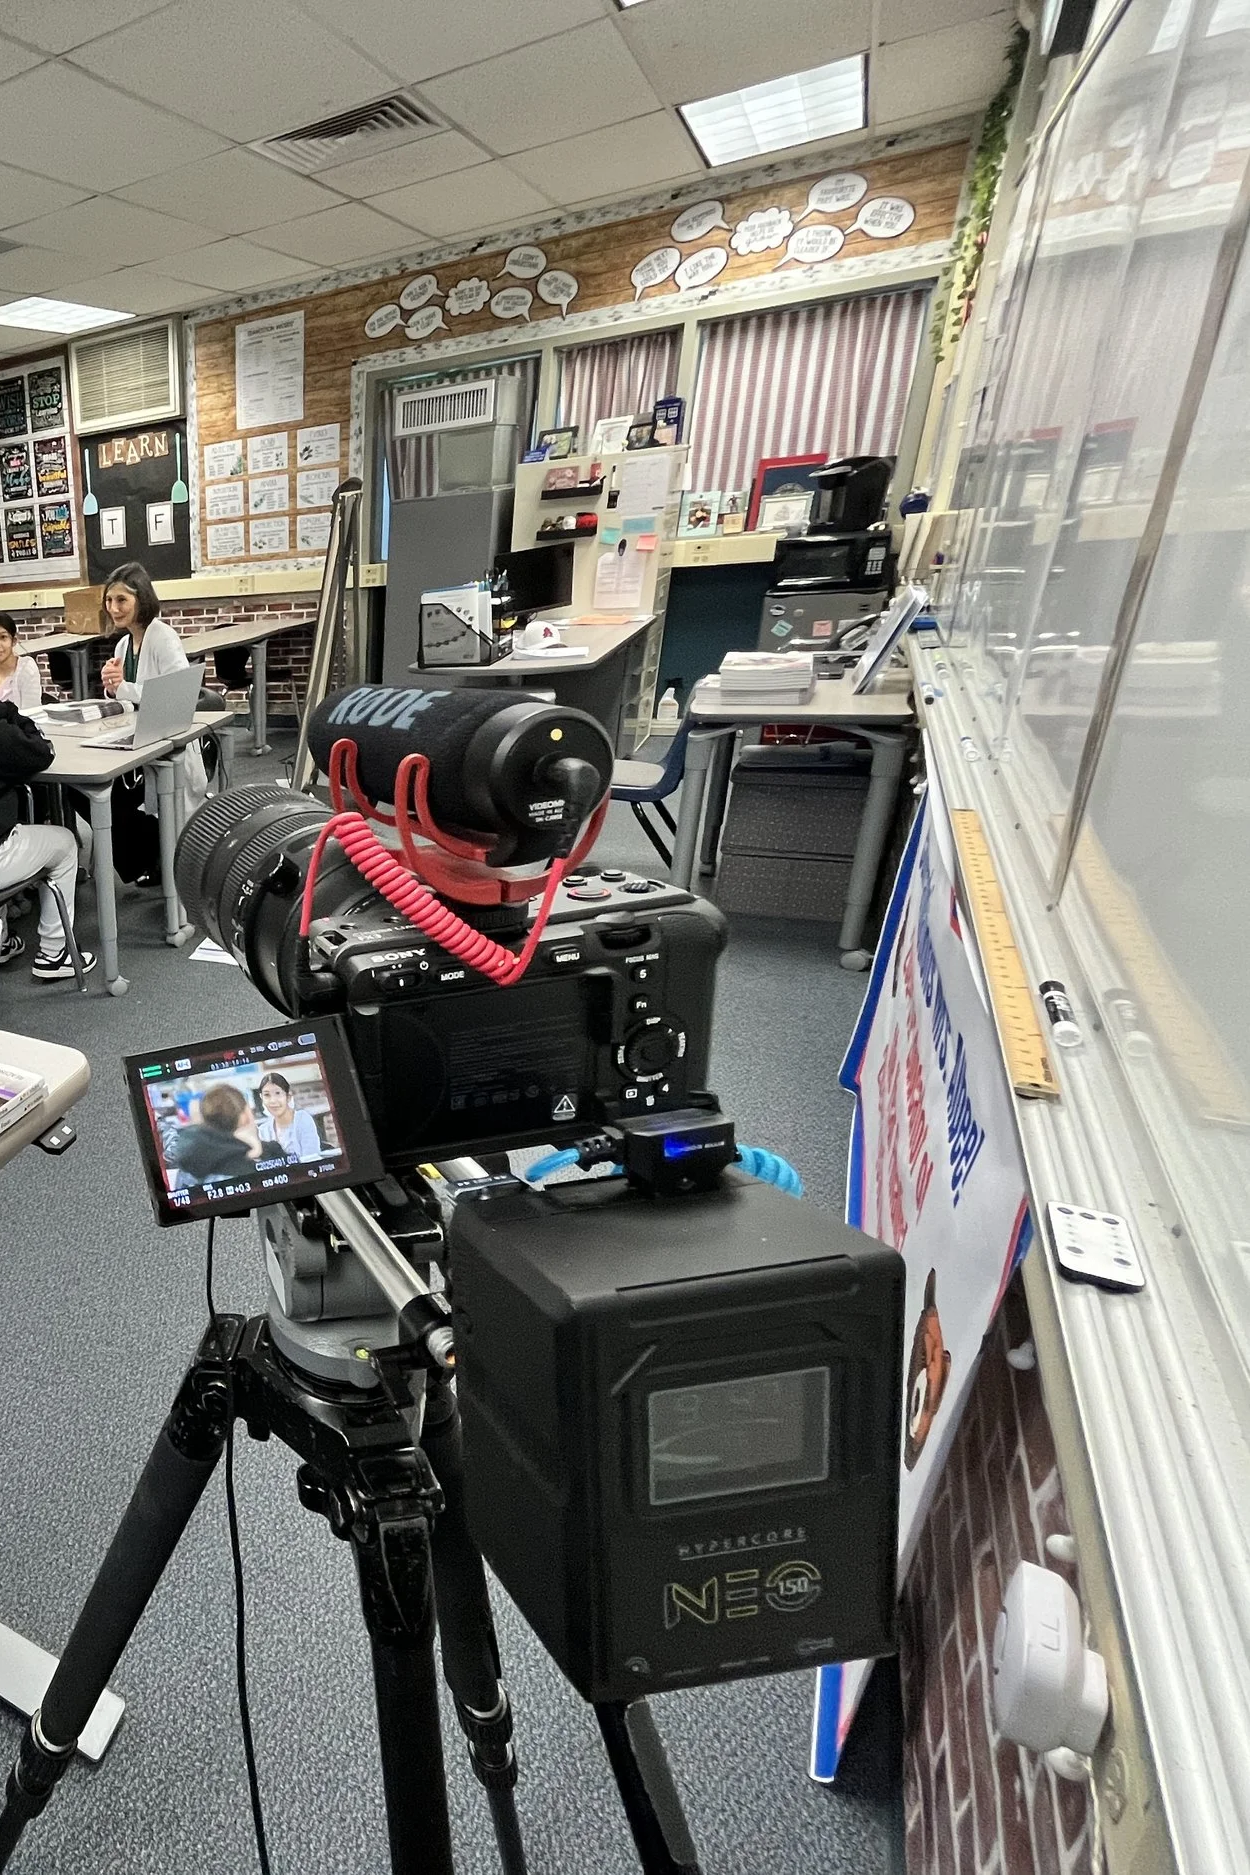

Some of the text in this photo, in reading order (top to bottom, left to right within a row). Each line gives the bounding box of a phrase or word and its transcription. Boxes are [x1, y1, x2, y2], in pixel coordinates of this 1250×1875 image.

[32, 393, 61, 409] STOP
[101, 432, 167, 466] LEARN
[107, 518, 118, 535] T
[154, 513, 165, 531] F
[371, 949, 426, 964] SONY
[555, 952, 580, 963] MENU
[440, 970, 465, 981] MODE
[636, 1001, 647, 1009] Fn
[274, 1174, 289, 1185] 400
[207, 1188, 224, 1200] F2.8
[235, 1182, 252, 1194] +0.3
[677, 1527, 807, 1557] HYPERCORE
[779, 1576, 809, 1596] 150
[663, 1560, 822, 1630] NEO
